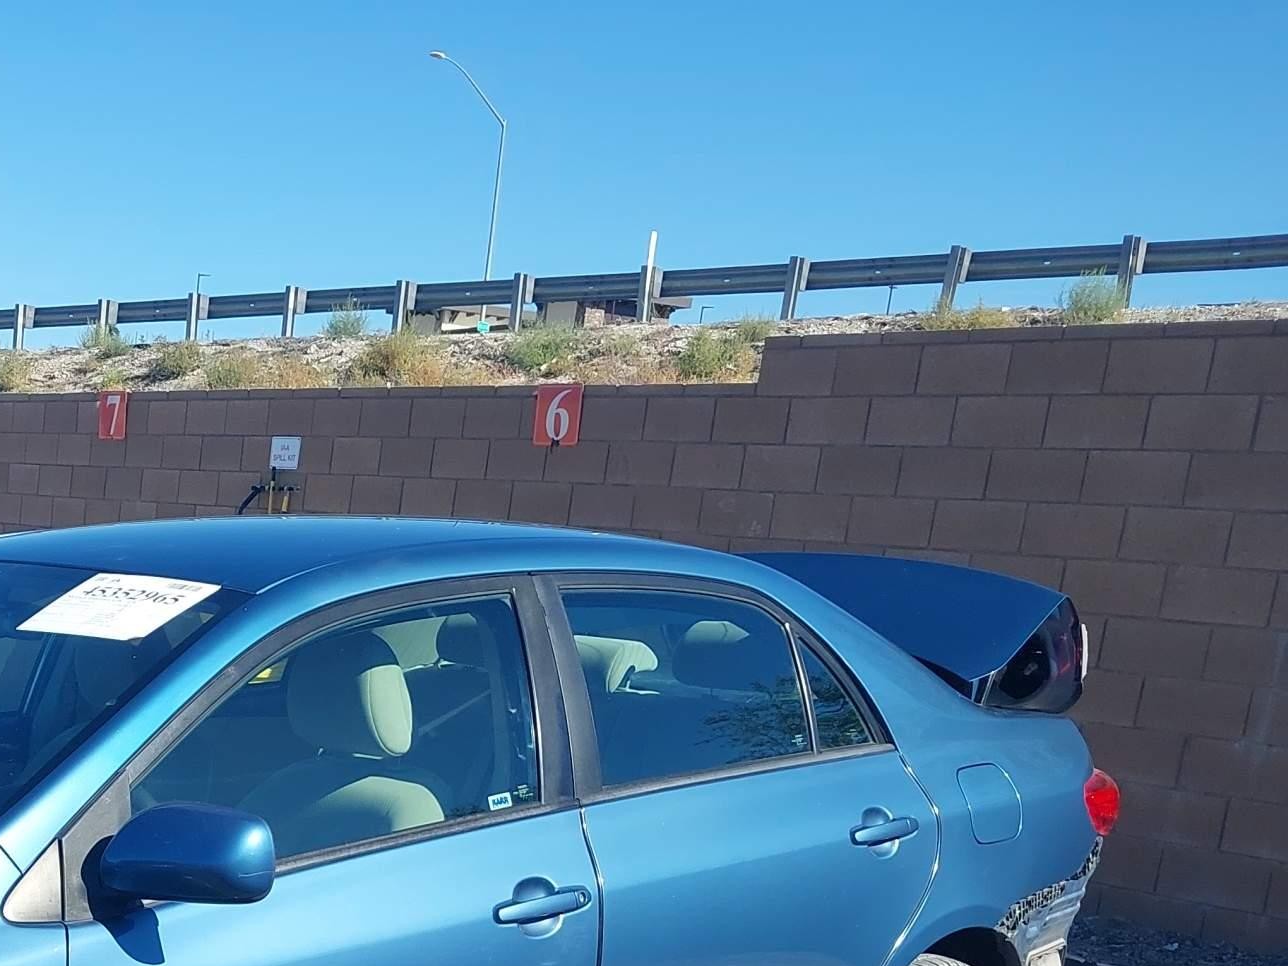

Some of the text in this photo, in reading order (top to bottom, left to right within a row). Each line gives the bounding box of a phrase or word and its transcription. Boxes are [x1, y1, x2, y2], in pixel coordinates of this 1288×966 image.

[107, 395, 121, 436] 7
[546, 389, 572, 440] 6
[83, 585, 186, 605] 45352965
